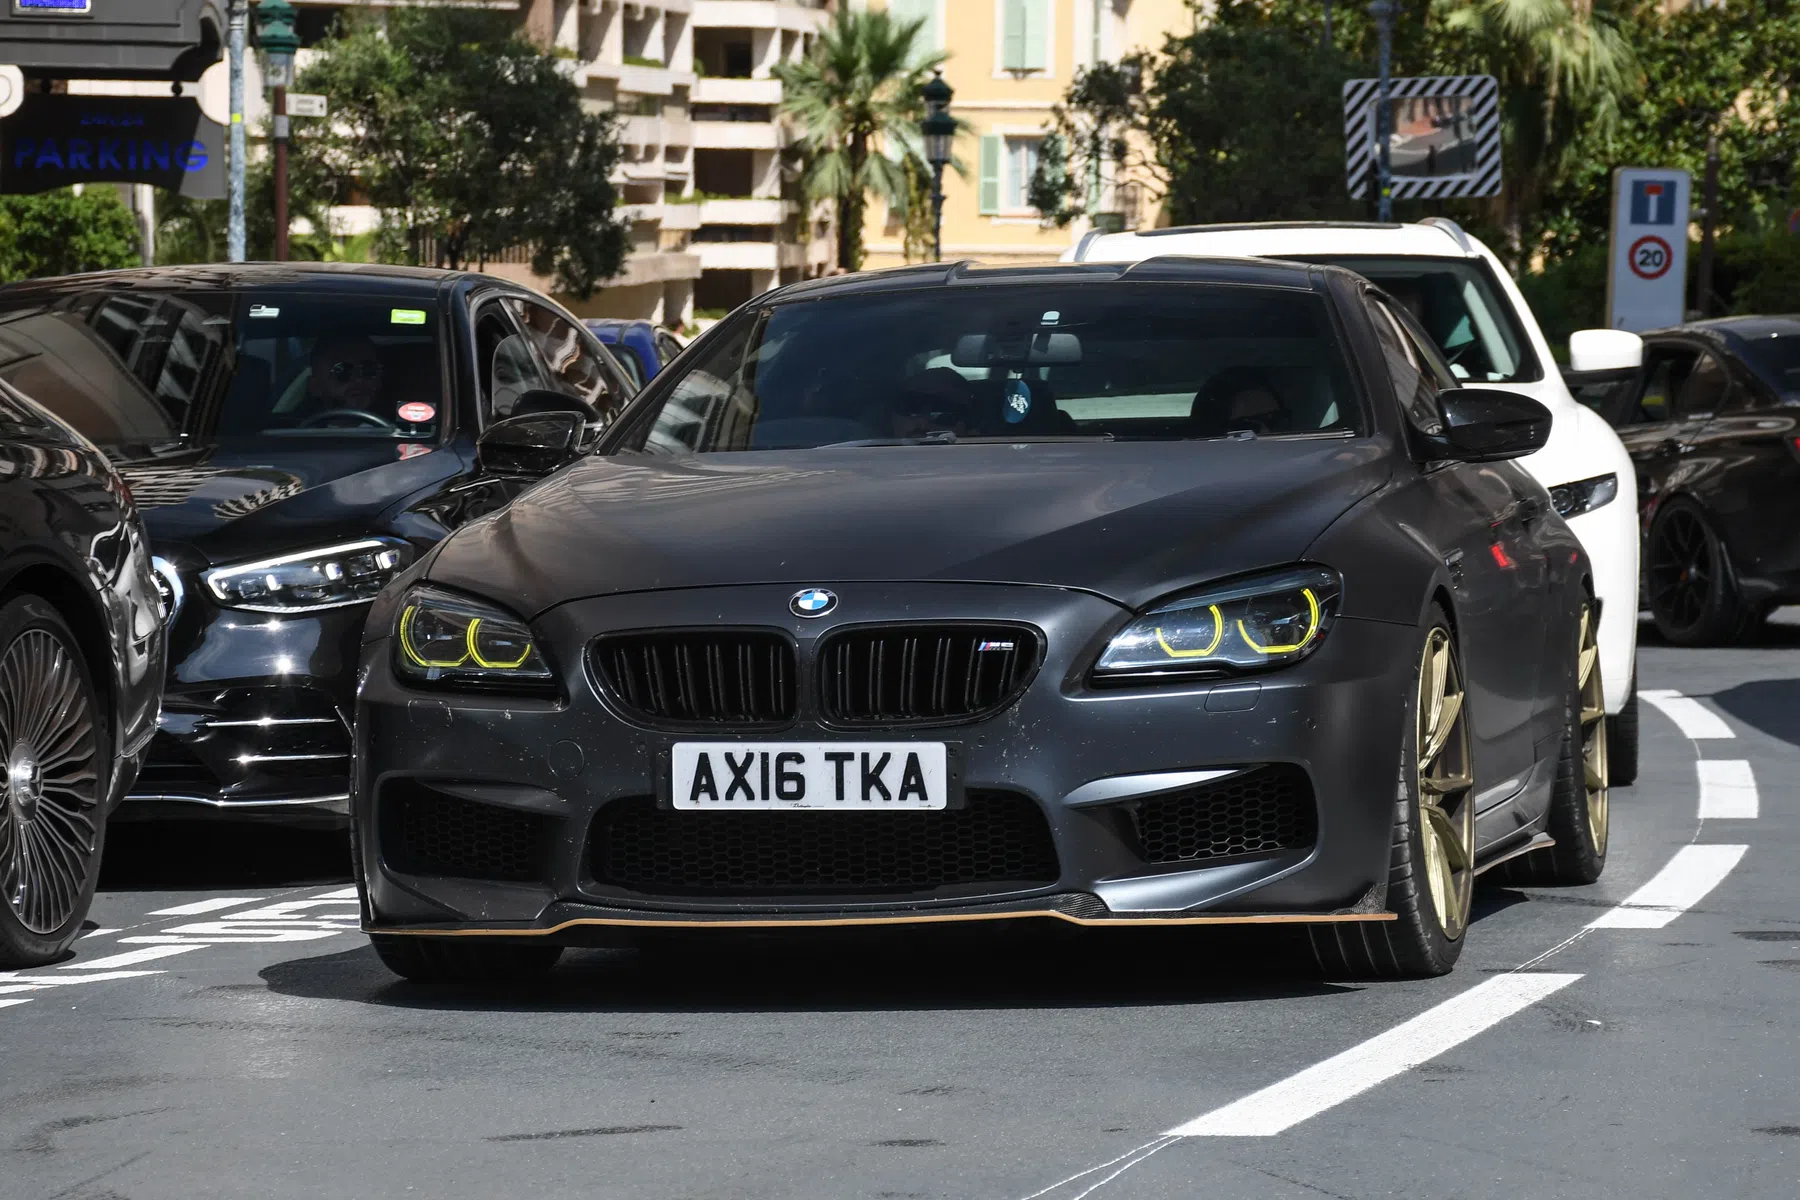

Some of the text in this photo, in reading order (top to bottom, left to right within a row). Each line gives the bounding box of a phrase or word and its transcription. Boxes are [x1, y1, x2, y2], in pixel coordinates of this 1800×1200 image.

[14, 136, 209, 174] PARKING
[1638, 248, 1664, 267] 20
[689, 751, 929, 801] AX16 TKA
